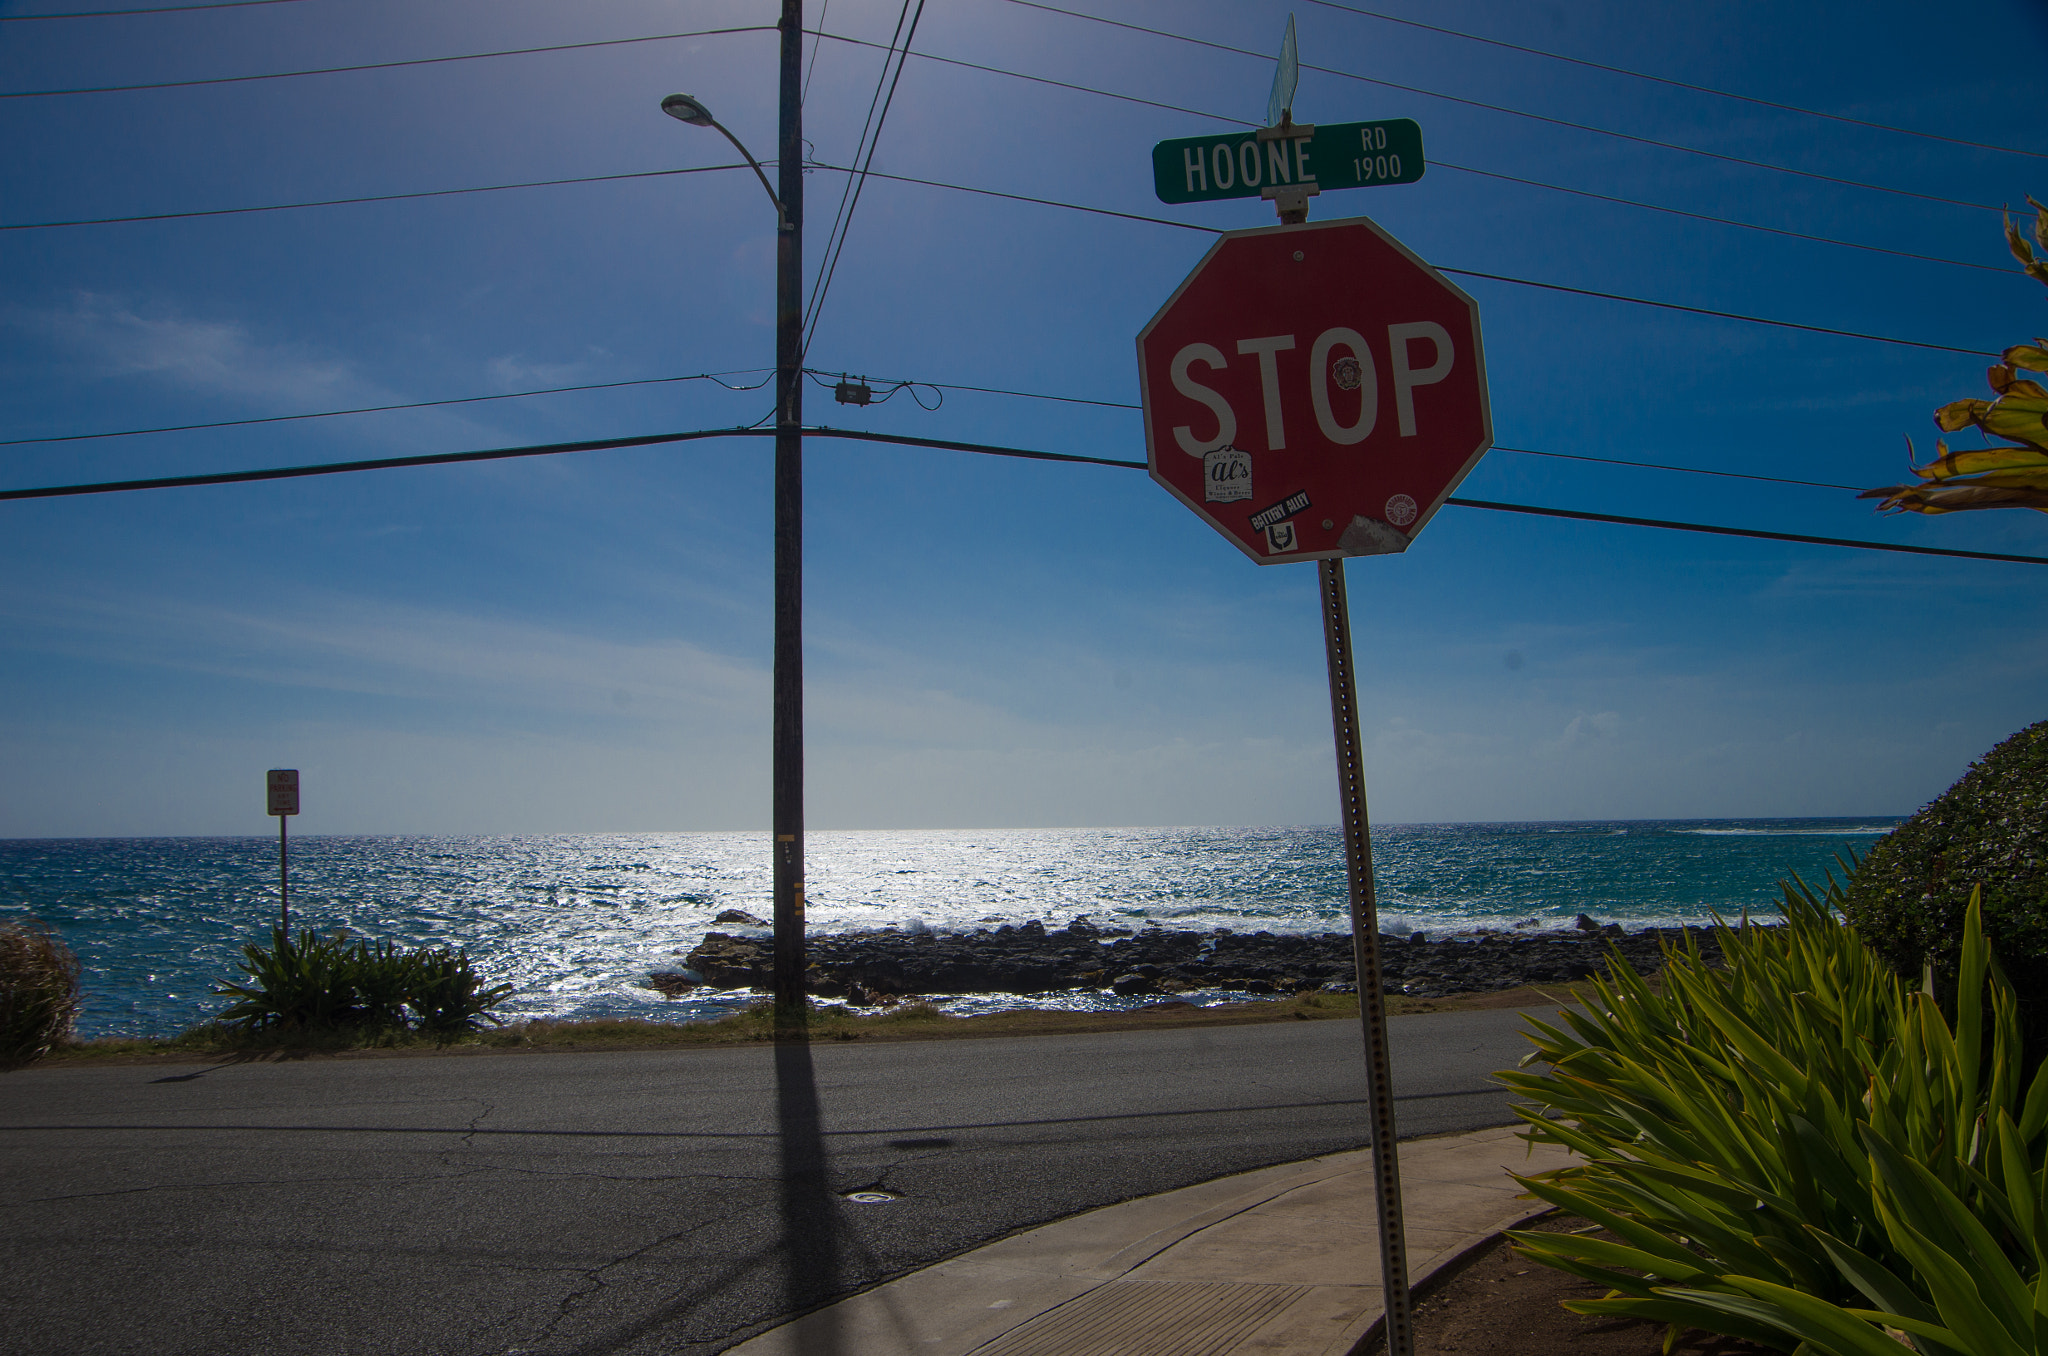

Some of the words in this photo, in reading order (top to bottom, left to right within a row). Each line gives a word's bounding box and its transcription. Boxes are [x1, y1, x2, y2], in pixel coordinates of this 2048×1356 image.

[1184, 136, 1316, 192] HOONE
[1361, 127, 1387, 151] RD
[1353, 154, 1401, 182] 1900
[1170, 320, 1455, 459] STOP
[1251, 503, 1286, 530] BATTERY
[1286, 491, 1310, 513] ALLEY
[270, 784, 297, 792] PARKING
[277, 774, 289, 782] NO
